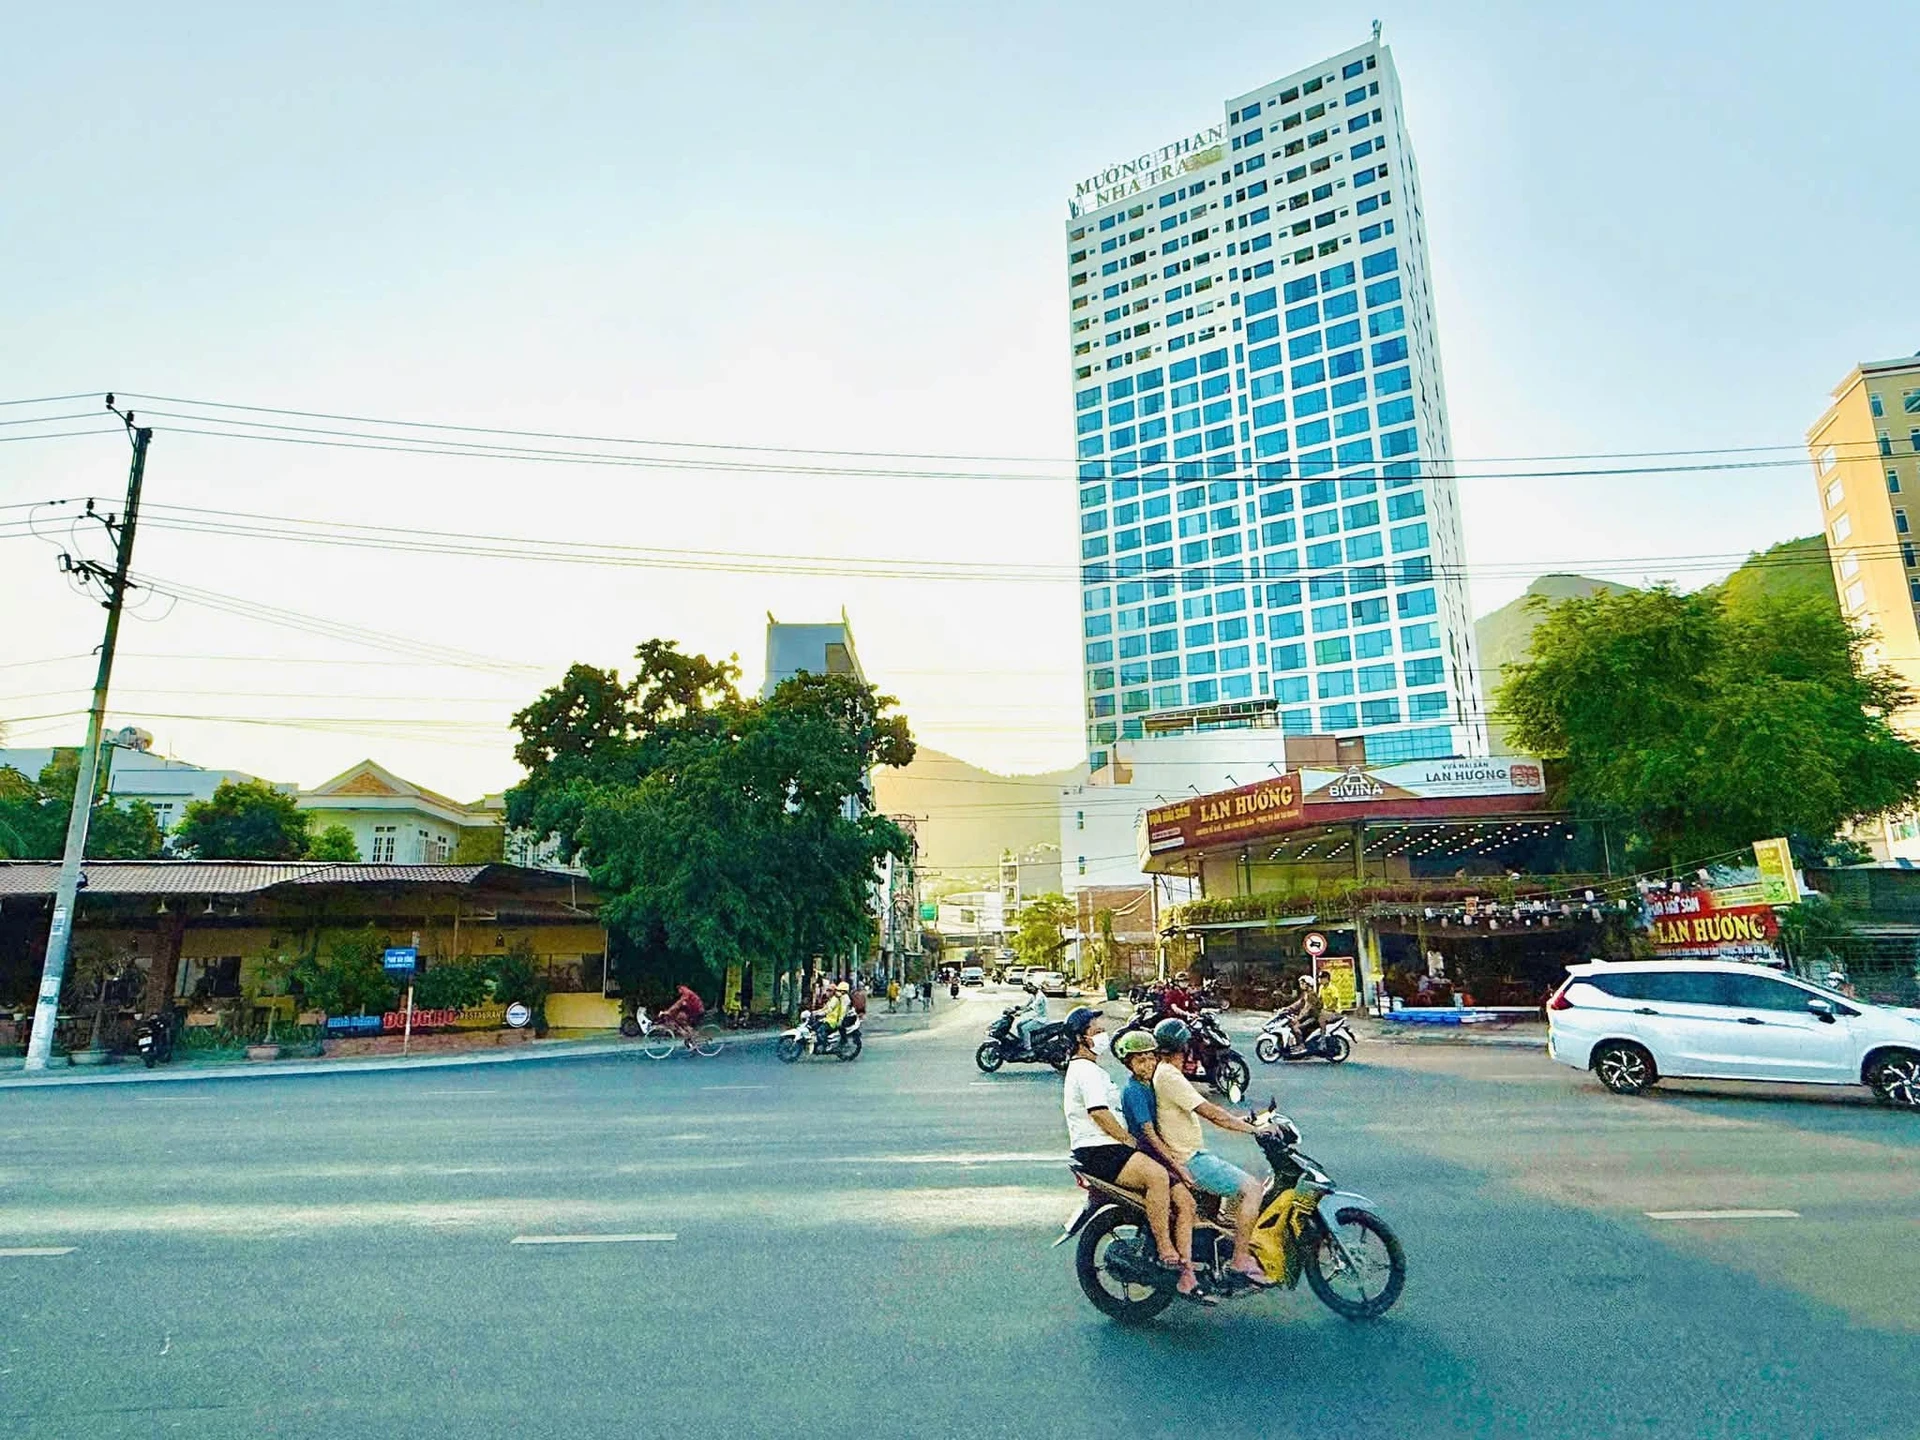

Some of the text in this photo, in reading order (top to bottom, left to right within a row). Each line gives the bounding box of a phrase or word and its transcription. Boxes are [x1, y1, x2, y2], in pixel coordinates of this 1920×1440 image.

[1096, 179, 1142, 208] NHA
[1425, 772, 1451, 782] LAN
[1329, 782, 1384, 797] BIVINA
[1200, 799, 1231, 823] LAN
[1656, 912, 1766, 944] LAN HƯƠNG
